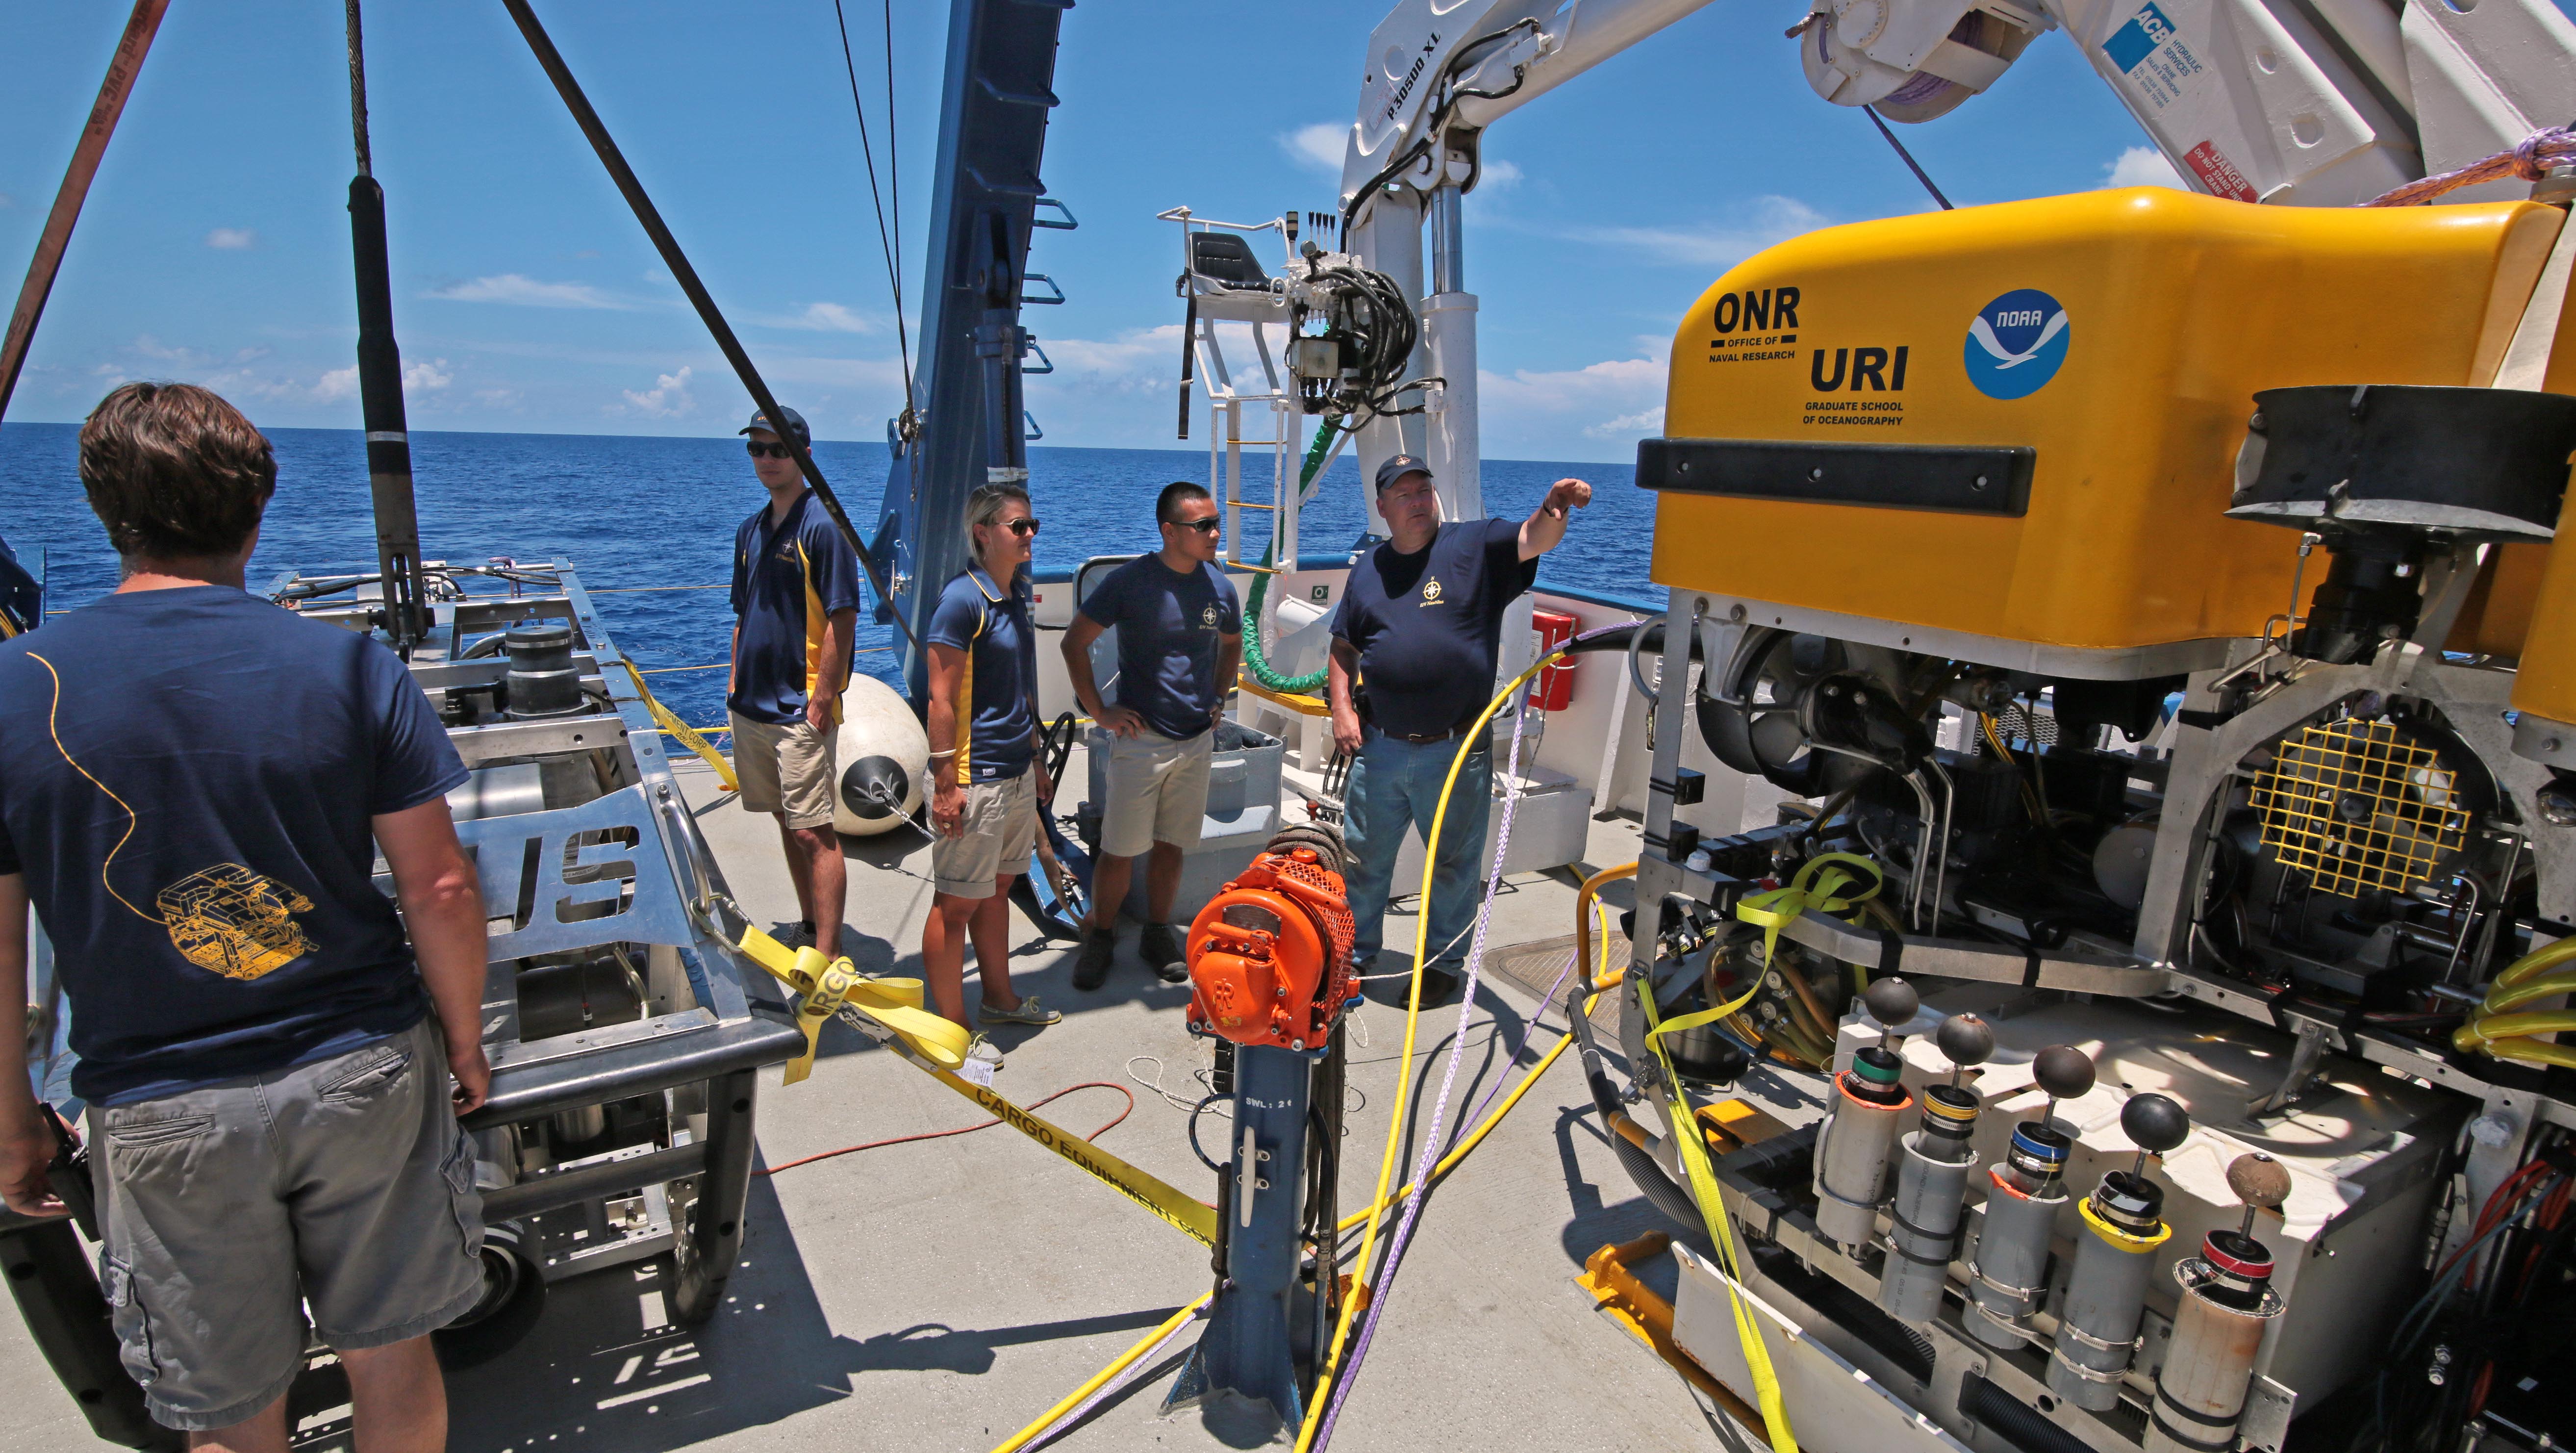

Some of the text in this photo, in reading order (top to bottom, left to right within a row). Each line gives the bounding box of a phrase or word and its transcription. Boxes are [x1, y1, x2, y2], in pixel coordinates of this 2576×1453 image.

[2134, 10, 2170, 44] ACB
[1423, 32, 1440, 58] XL
[2172, 39, 2202, 73] HYDRAULIC
[2146, 57, 2159, 72] SALES
[2160, 74, 2180, 97] SERVICING
[2162, 64, 2176, 79] CRANE
[2164, 47, 2190, 76] SERVICES
[101, 65, 128, 102] PVC
[2194, 148, 2204, 158] DO
[2202, 157, 2216, 171] NOT
[2212, 170, 2231, 190] STAND
[2212, 153, 2247, 193] DANGER
[2205, 175, 2223, 196] CRANE
[1714, 287, 1800, 333] ONR
[1996, 309, 2042, 328] NOAA
[1727, 335, 1778, 347] OFFICE OF
[1709, 351, 1795, 363] NAVAL RESEARCH
[1811, 346, 1908, 392] URI
[1803, 415, 1903, 426] OF OCEANOGRAPHY
[1805, 402, 1903, 411] GRADUATE SCHOOL
[975, 1087, 1053, 1146] CARGO
[1060, 1140, 1171, 1221] EQUIPMENT
